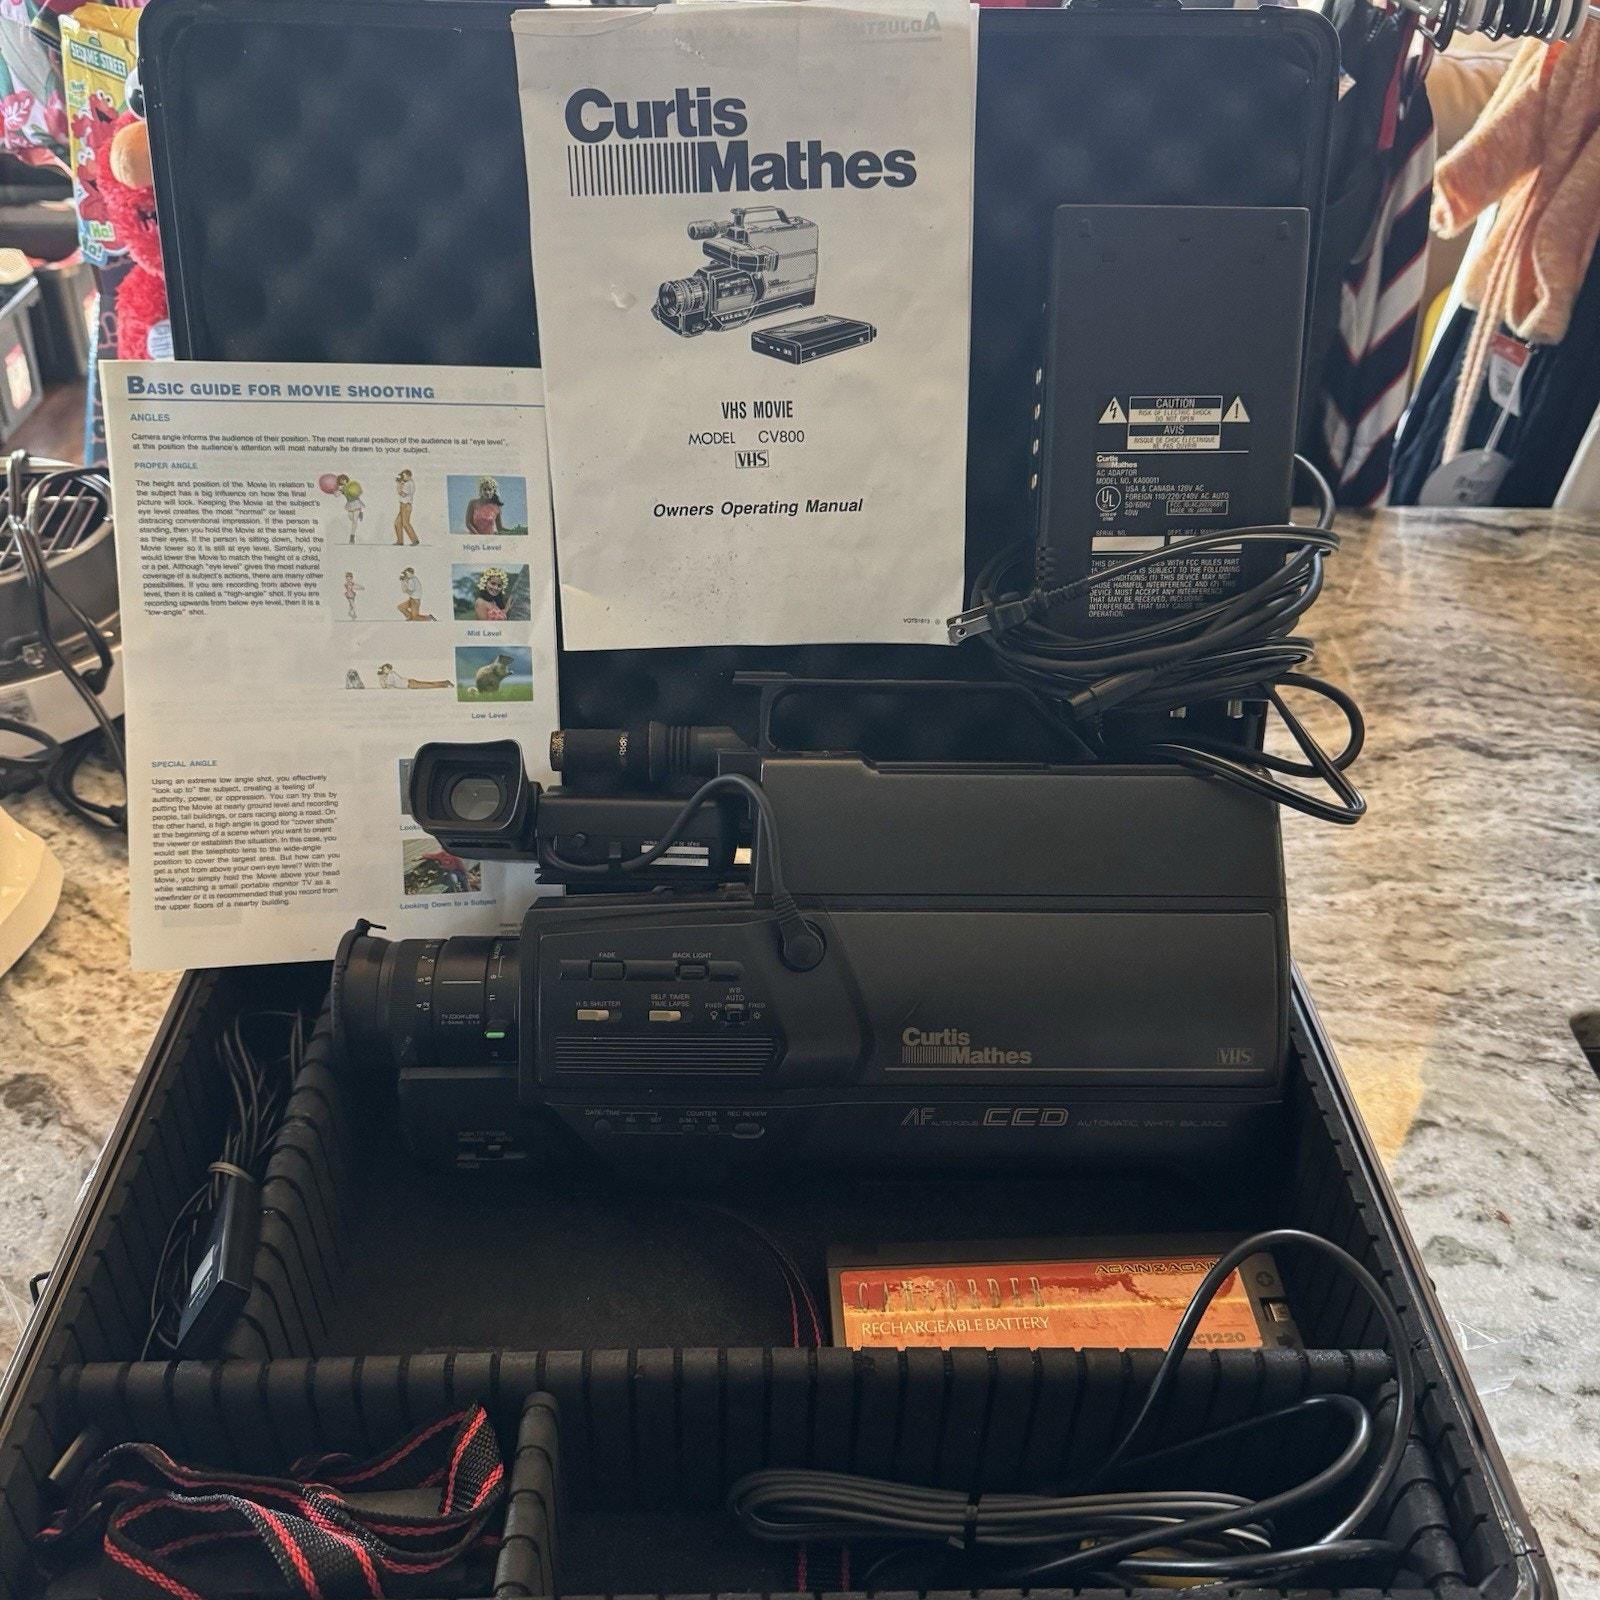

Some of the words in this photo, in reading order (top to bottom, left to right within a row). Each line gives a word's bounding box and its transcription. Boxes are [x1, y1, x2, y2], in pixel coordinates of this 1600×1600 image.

[565, 87, 748, 144] Curtis
[698, 140, 917, 193] Mathes
[127, 375, 184, 395] BASIC
[190, 382, 241, 396] GUIDE
[249, 383, 281, 397] FOR
[288, 384, 341, 398] MOVIE
[347, 385, 435, 399] SHOOTING
[722, 401, 747, 419] VHS
[753, 400, 793, 418] MOVIE
[1156, 398, 1195, 408] CAUTION
[130, 413, 170, 422] ANGLES
[688, 431, 736, 445] MODEL
[758, 430, 804, 443] CV800
[1164, 425, 1185, 435] AVIS
[134, 462, 168, 470] PROPER
[736, 450, 769, 468] VHS
[653, 503, 714, 517] Owners
[721, 501, 798, 517] Operating
[805, 498, 863, 513] Manual
[463, 543, 480, 552] High
[482, 543, 501, 551] Level
[471, 712, 487, 720] Low
[152, 760, 186, 768] SPECIAL
[400, 902, 429, 911] Looking
[470, 899, 497, 908] Subject
[902, 1027, 971, 1046] Curtis
[952, 1047, 1032, 1065] Mathes
[1217, 1047, 1253, 1065] VHS
[983, 1107, 1070, 1127] CCD
[1096, 1264, 1151, 1274] AGAIN
[862, 1318, 983, 1335] RECHARGEABLE
[985, 1316, 1049, 1333] BATTERY
[1192, 1332, 1246, 1344] C1220
